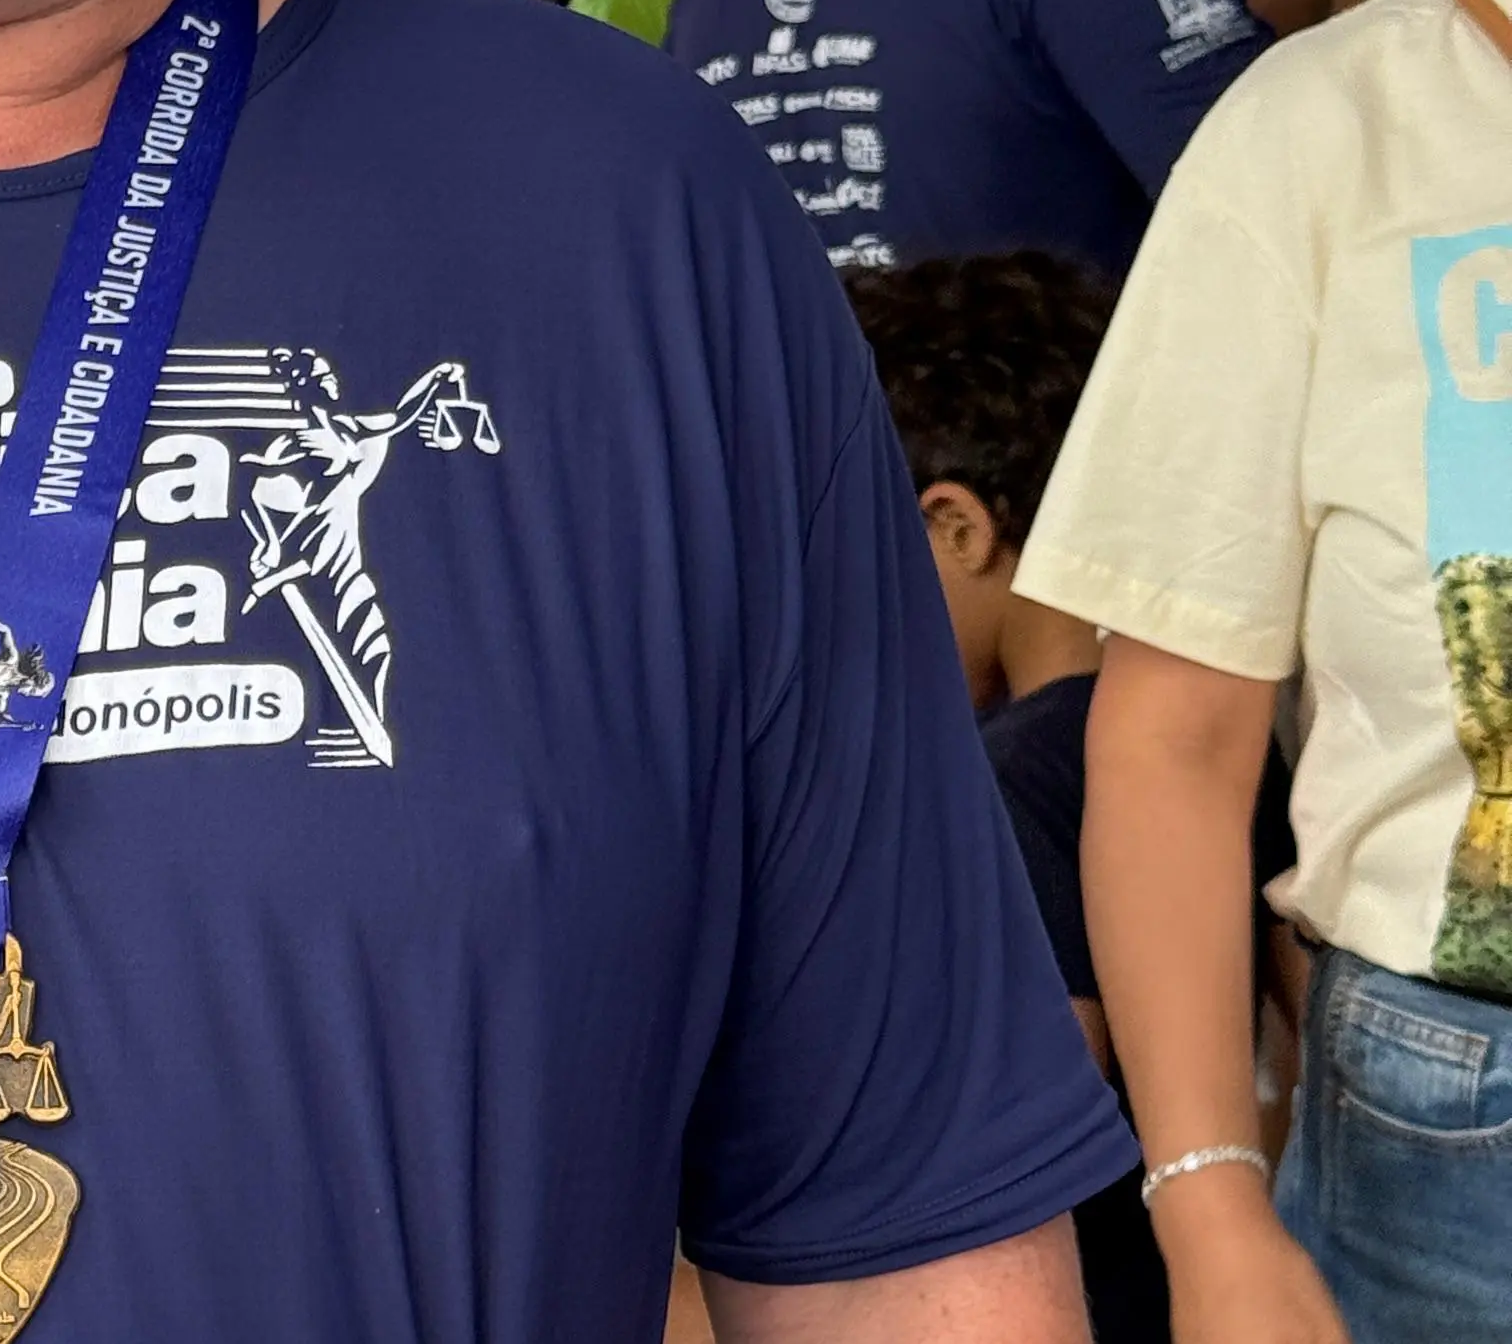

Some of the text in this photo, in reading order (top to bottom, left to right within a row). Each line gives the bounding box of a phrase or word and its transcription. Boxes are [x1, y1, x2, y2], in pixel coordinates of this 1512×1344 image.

[29, 15, 221, 516] 2ª CORRIDA DA JUSTIÇA E CIDADANIA
